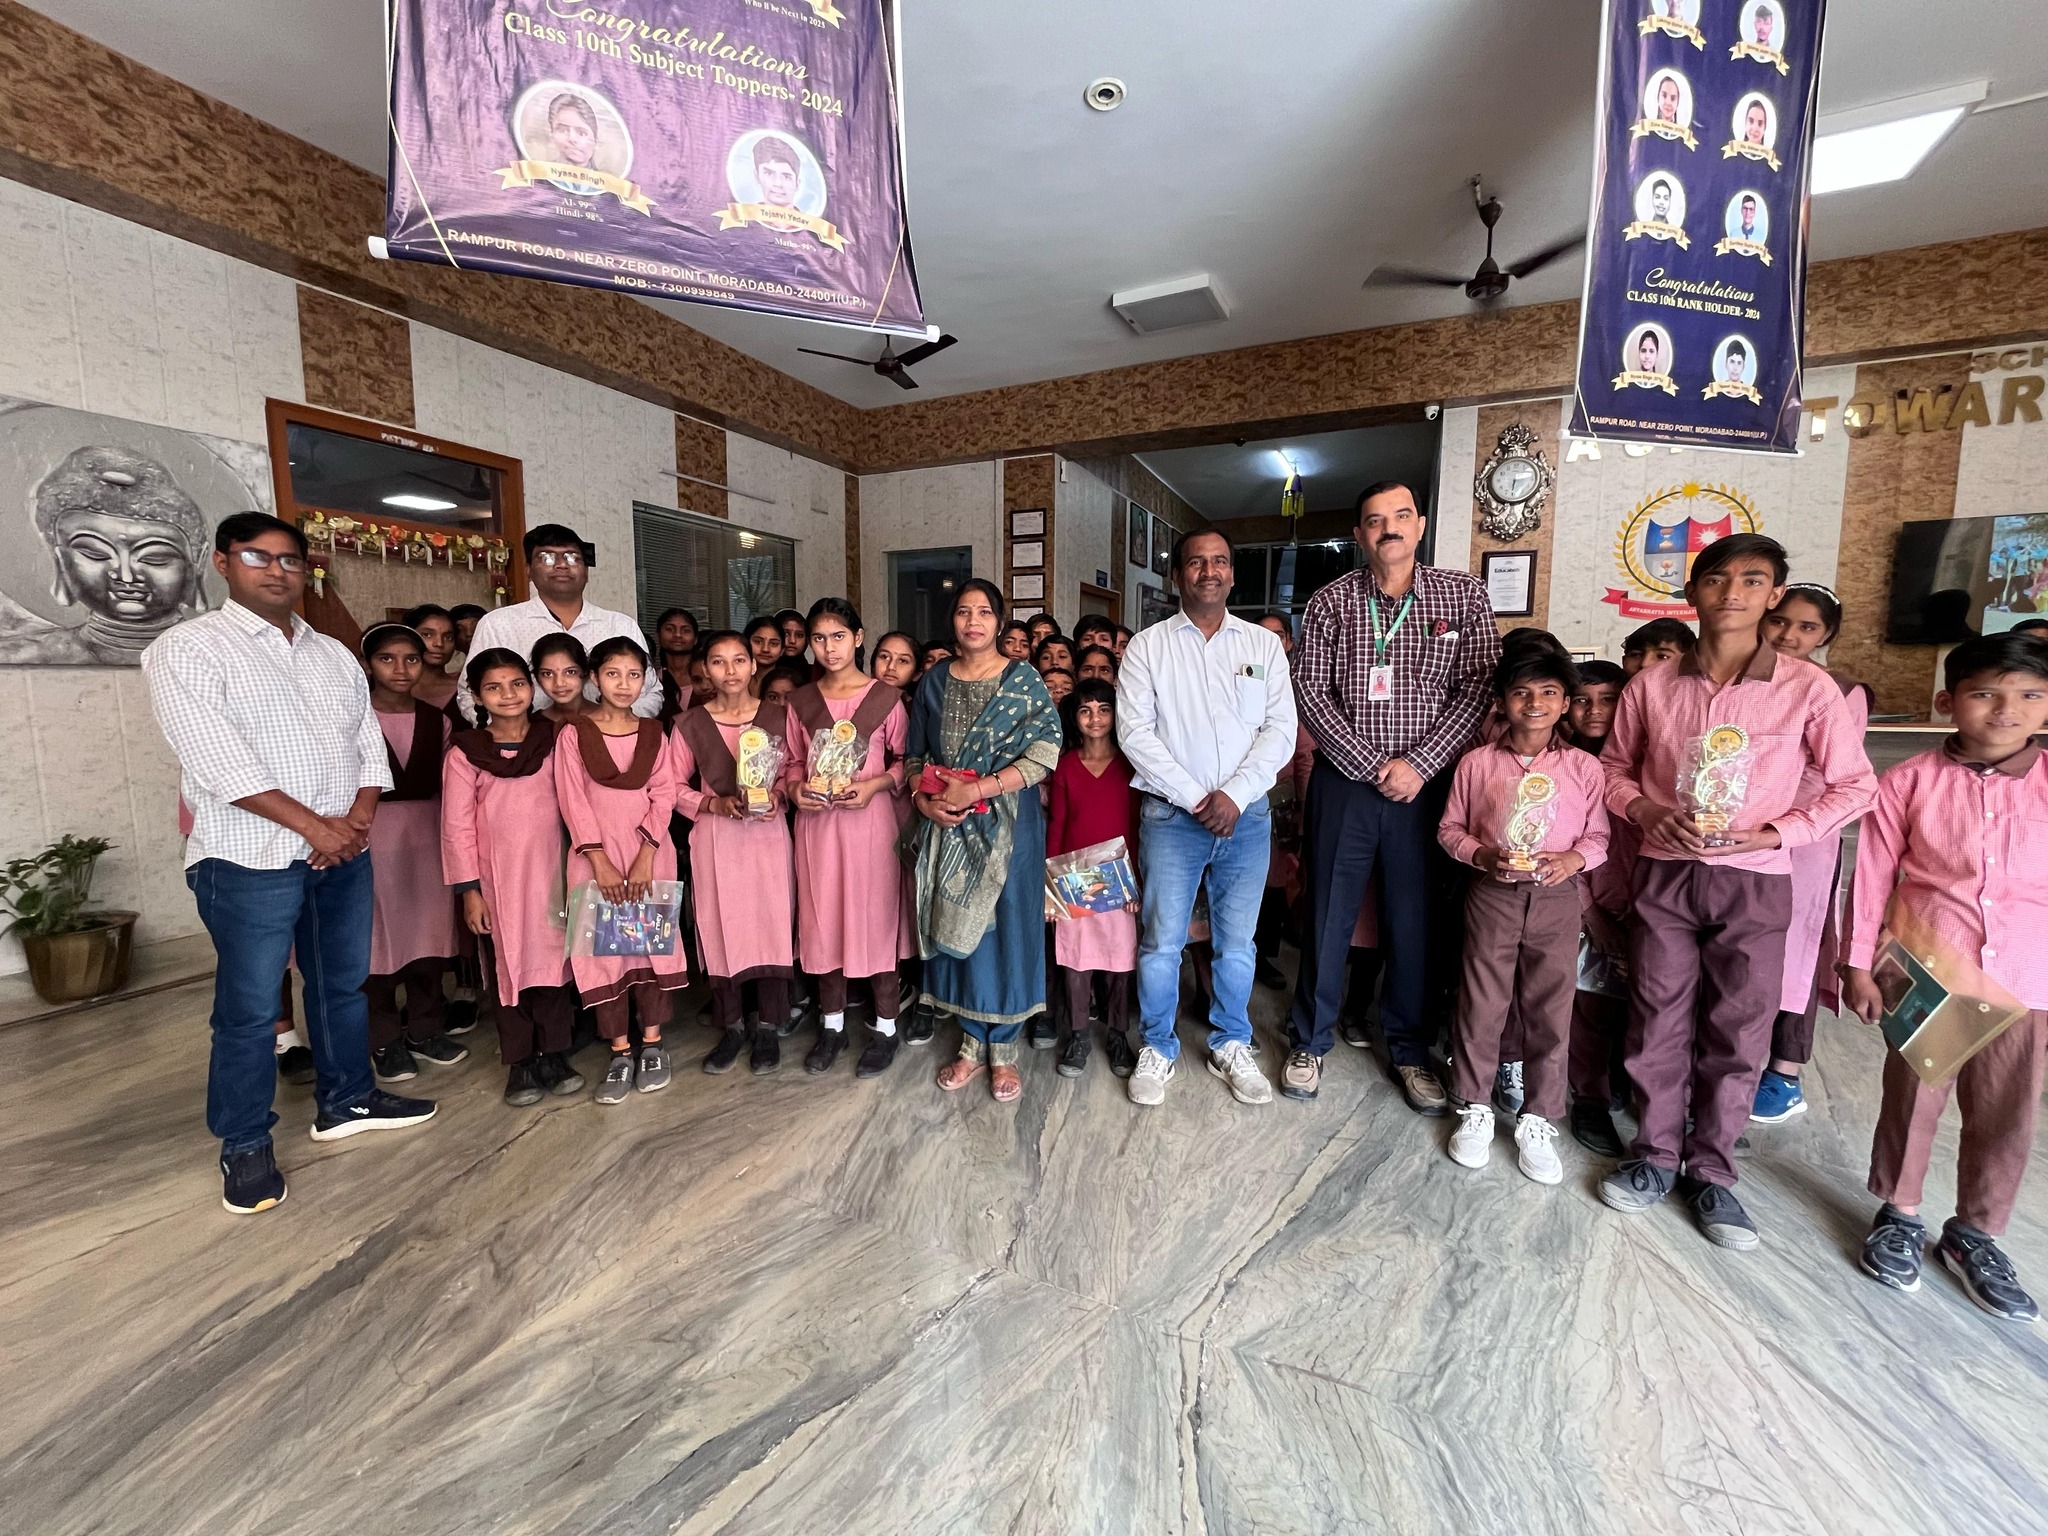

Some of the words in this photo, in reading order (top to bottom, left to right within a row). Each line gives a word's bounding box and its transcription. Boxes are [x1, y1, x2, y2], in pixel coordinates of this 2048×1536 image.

[504, 12, 567, 45] Class
[575, 30, 623, 59] 10th
[628, 44, 705, 79] Subject
[710, 65, 796, 100] Toppers-
[801, 89, 843, 117] 2024
[550, 167, 578, 179] Nyasa
[580, 173, 605, 186] Singh
[447, 228, 518, 253] RAMPUR
[574, 251, 616, 269] NEAR
[618, 259, 659, 275] ZERO
[661, 265, 706, 285] POINT,
[1645, 267, 1756, 303] Congratulations
[1626, 290, 1658, 304] CLASS
[1677, 297, 1704, 311] RANK
[1590, 416, 1617, 426] RAMPUR
[1639, 421, 1656, 430] NEAR
[1656, 423, 1674, 431] ZERO
